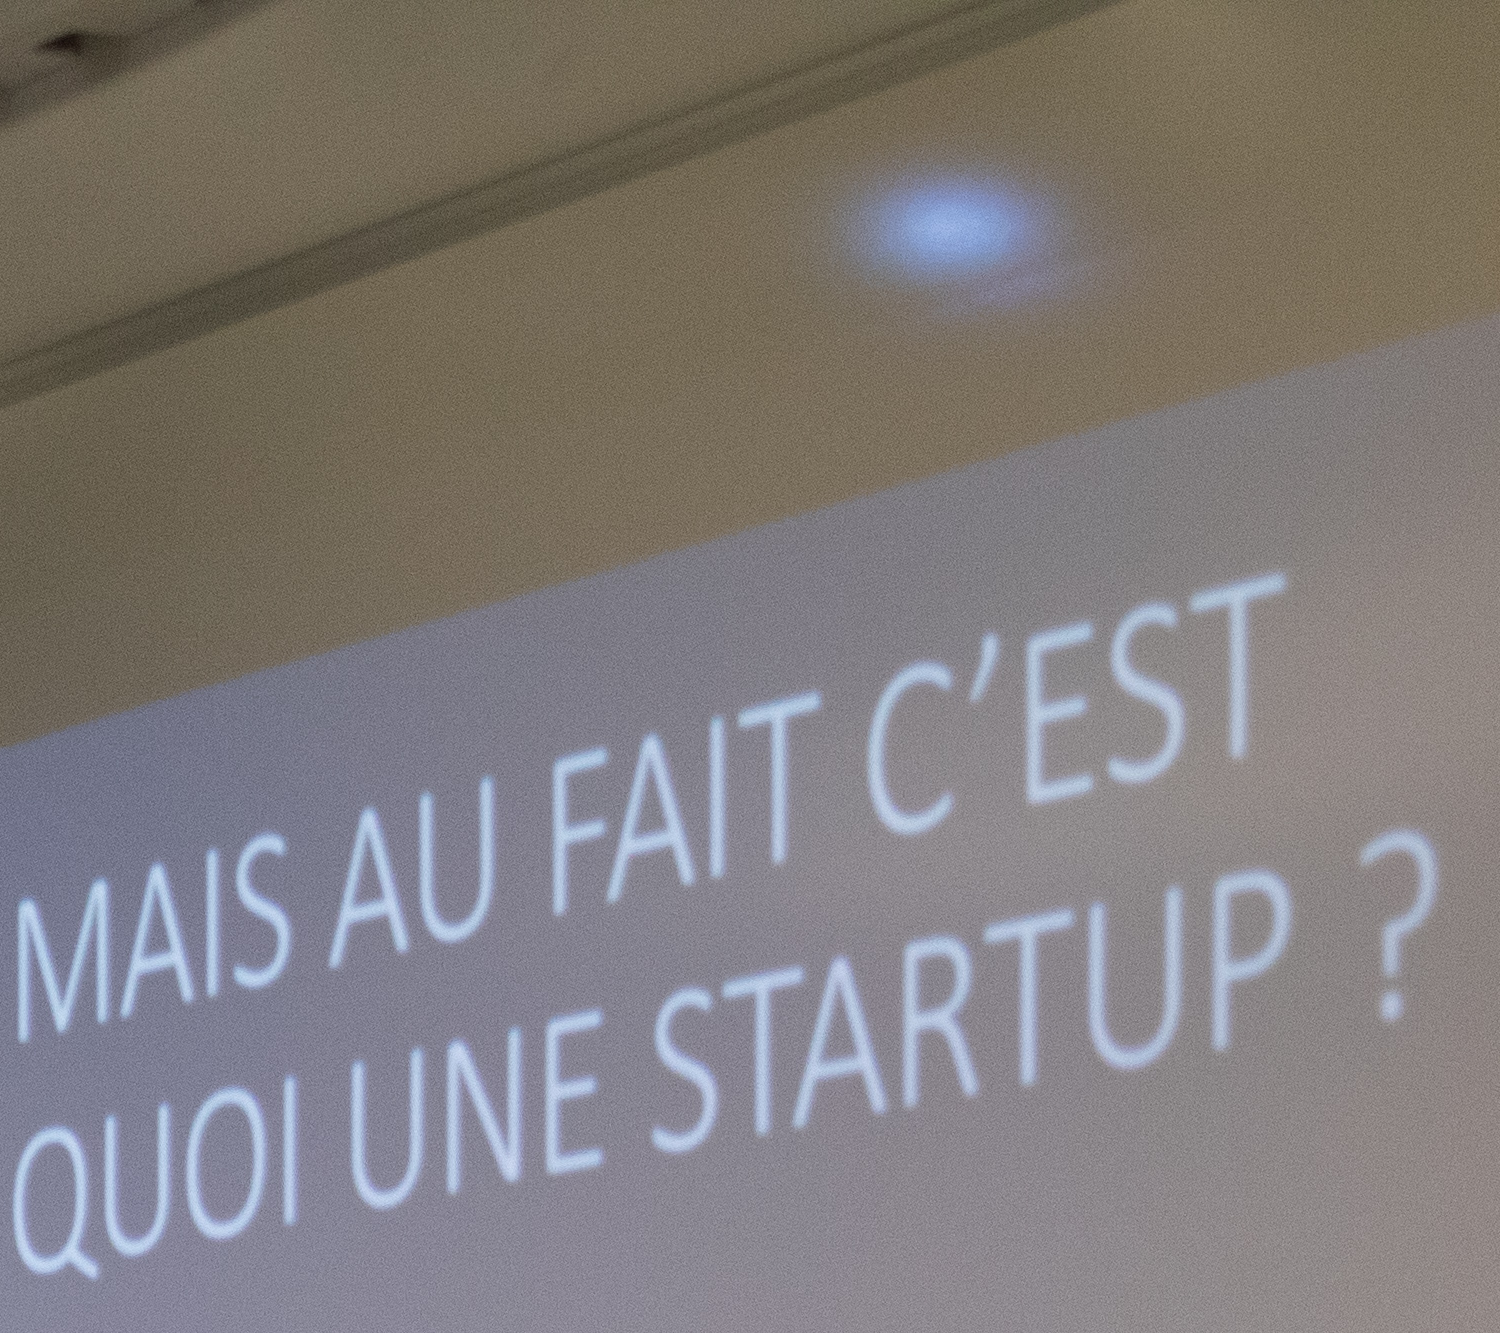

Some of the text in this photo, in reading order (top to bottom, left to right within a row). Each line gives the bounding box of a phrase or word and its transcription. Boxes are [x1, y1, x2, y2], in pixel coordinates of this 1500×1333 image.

[17, 571, 1288, 1043] MAIS AU FAIT C'EST
[12, 827, 1439, 1279] QUOI UNE STARTUP ?
